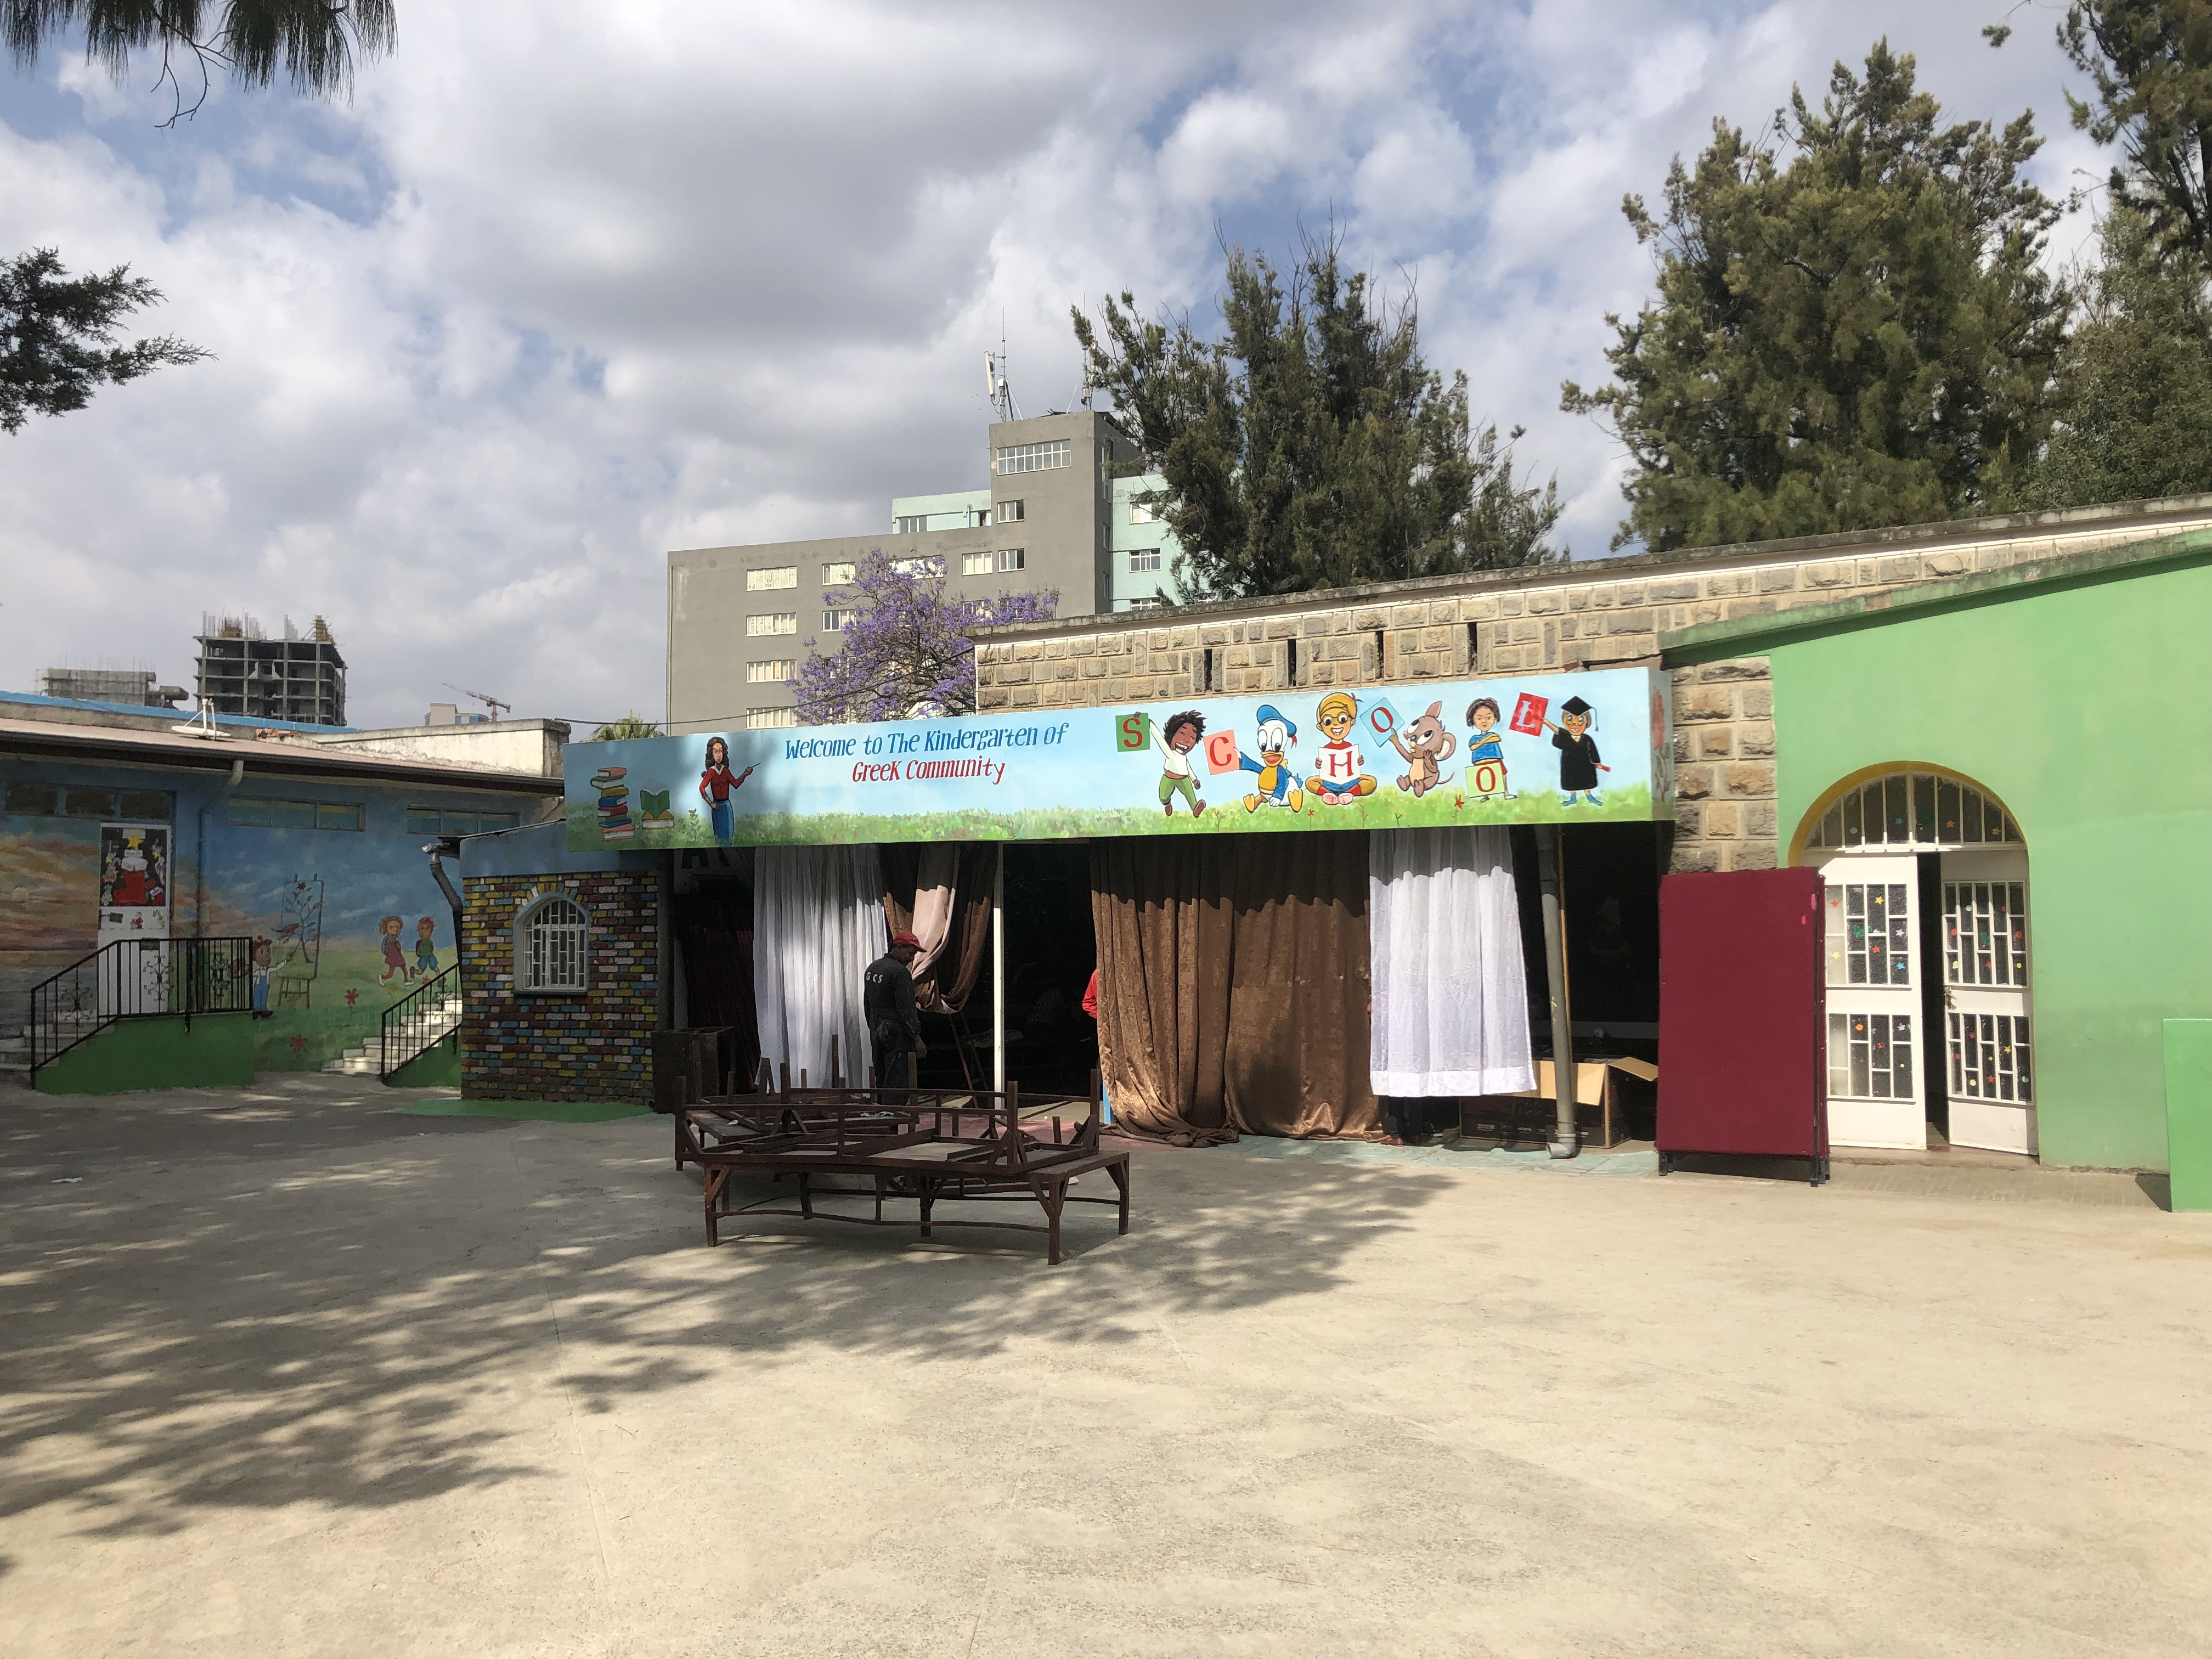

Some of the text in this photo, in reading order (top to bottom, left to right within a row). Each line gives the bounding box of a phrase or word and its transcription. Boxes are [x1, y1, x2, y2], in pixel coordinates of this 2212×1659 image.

[785, 723, 1070, 759] Welcome to The Kindergarten of
[1122, 718, 1143, 748] S
[1209, 736, 1232, 766] C
[1329, 751, 1355, 777] H
[1371, 707, 1394, 733] O
[1476, 766, 1496, 792] O
